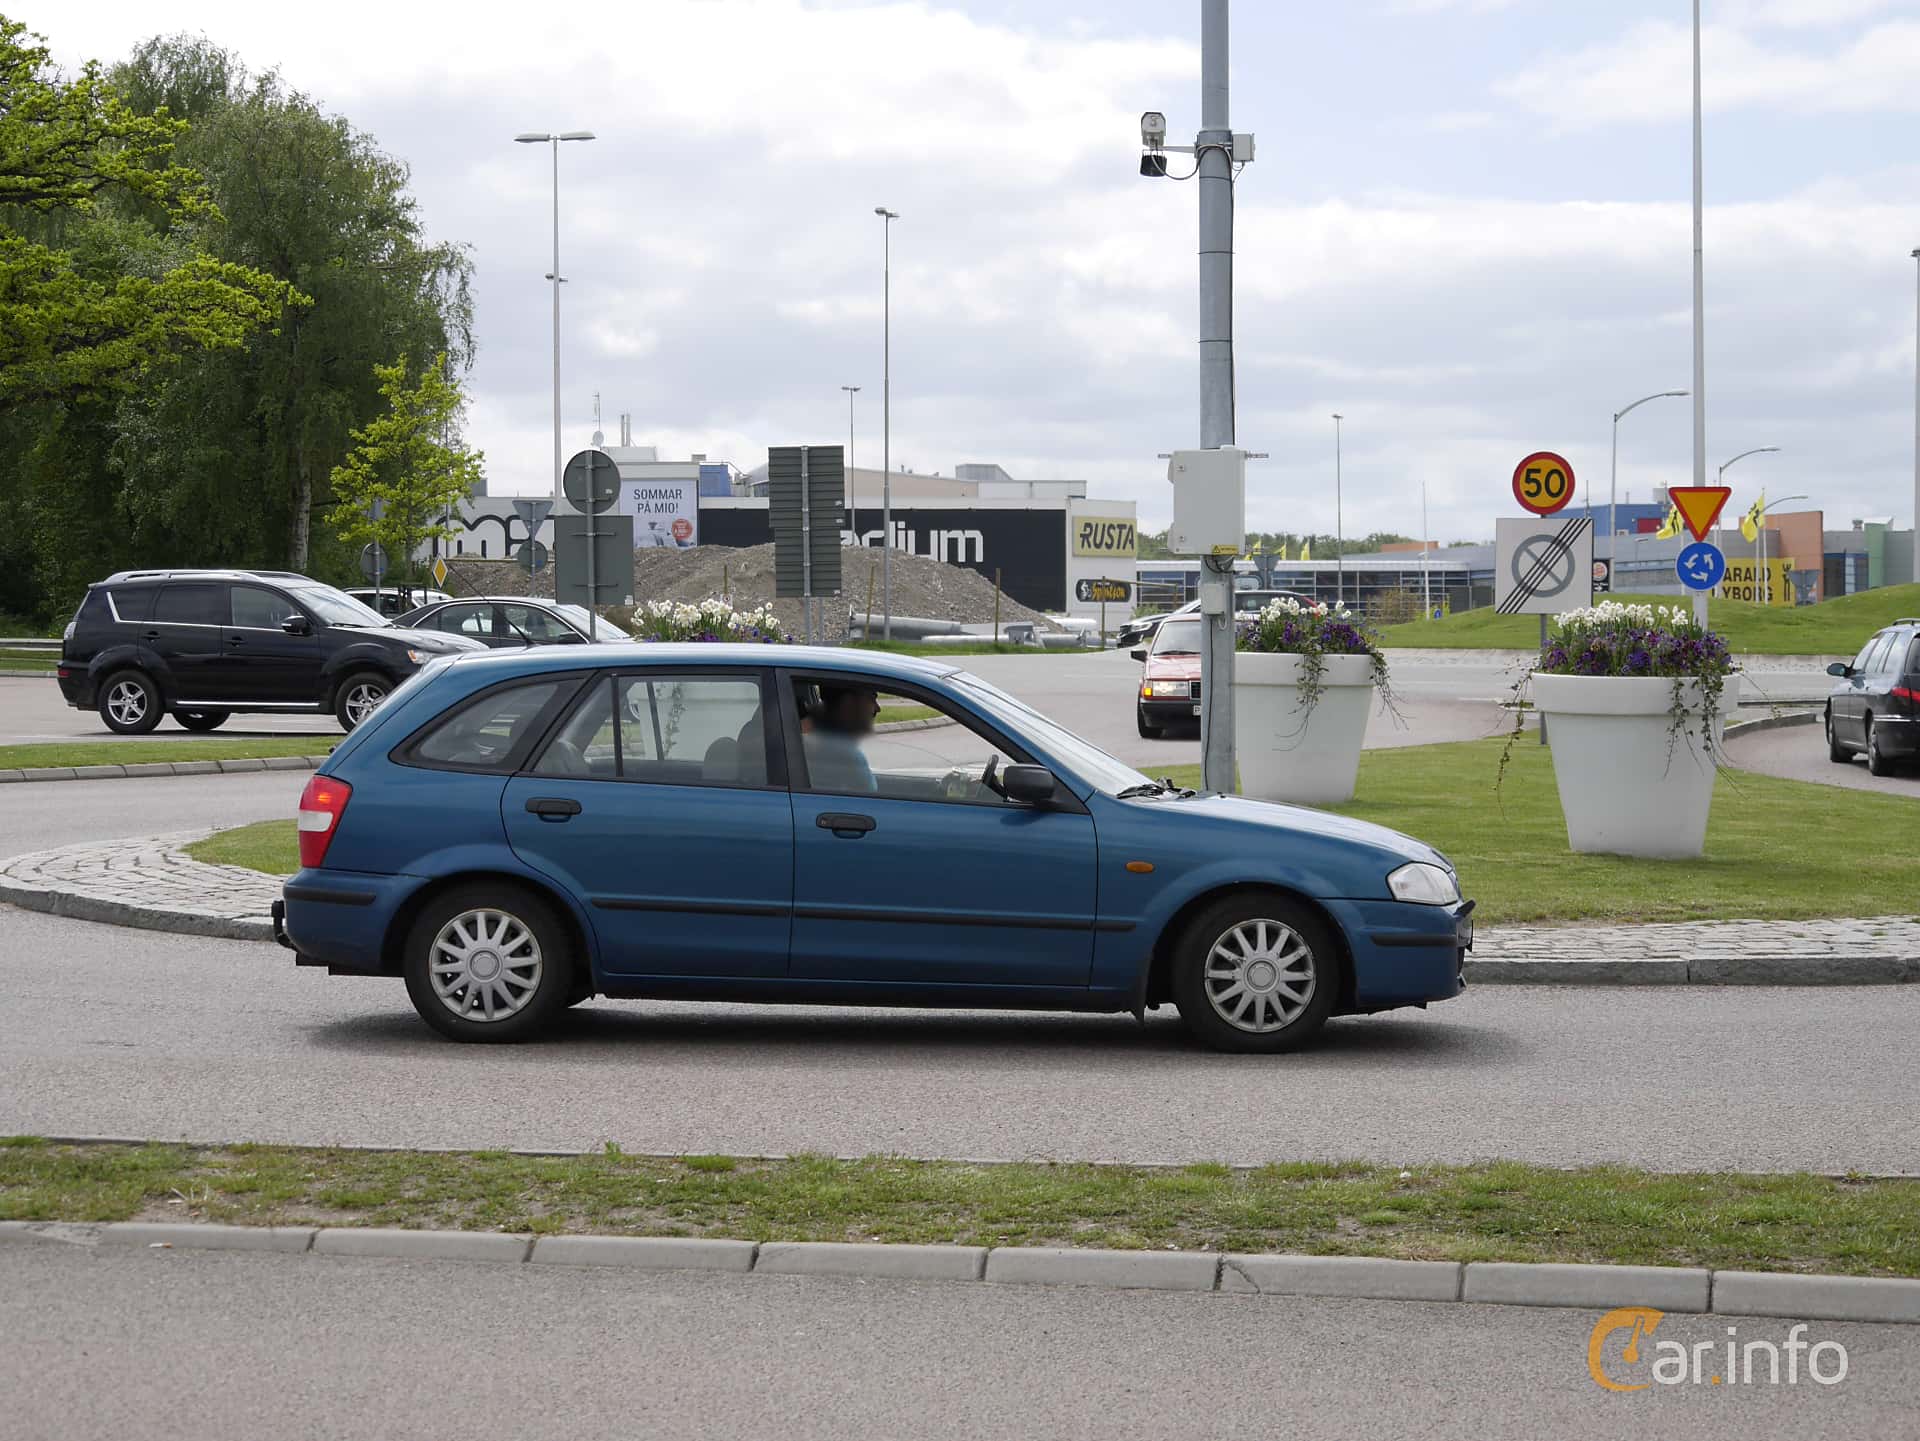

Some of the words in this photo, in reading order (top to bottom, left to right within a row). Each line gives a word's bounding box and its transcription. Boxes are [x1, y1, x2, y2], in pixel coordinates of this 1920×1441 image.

[1524, 468, 1565, 498] 50
[633, 488, 683, 500] SOMMAR
[637, 500, 652, 514] PÅ
[654, 502, 679, 513] MIO!
[1080, 522, 1135, 550] RUSTA
[1723, 567, 1772, 582] ARALD
